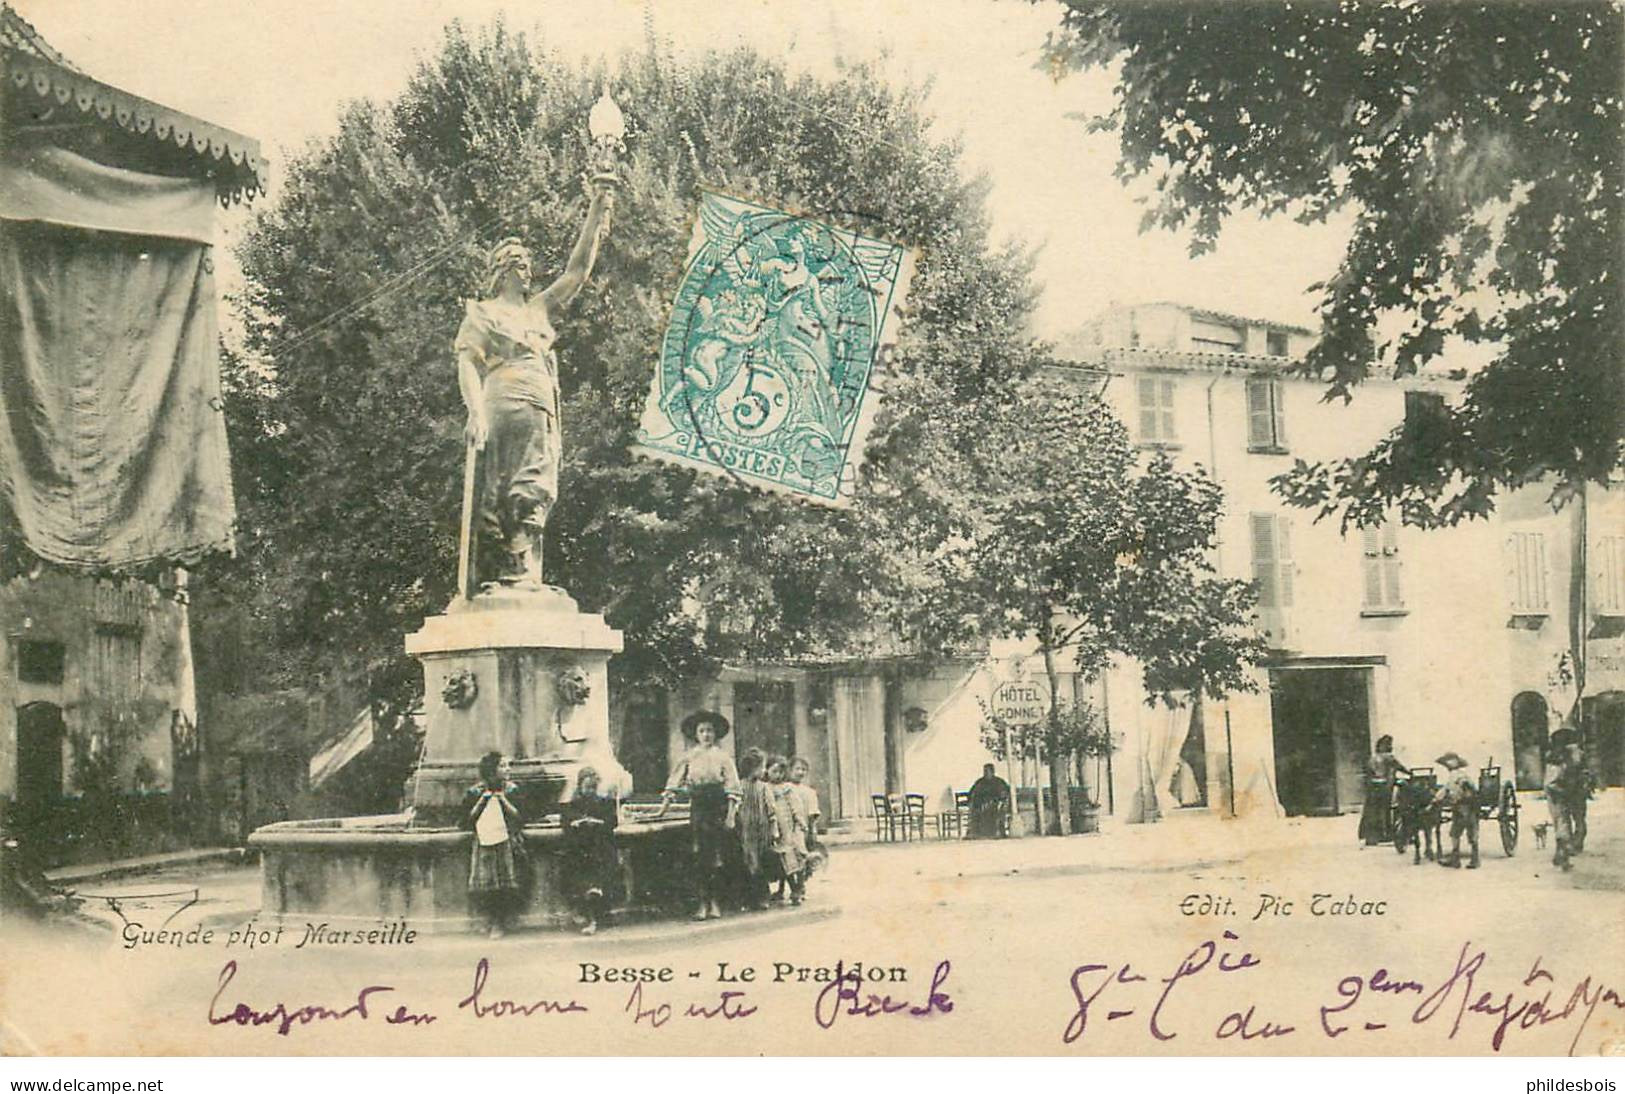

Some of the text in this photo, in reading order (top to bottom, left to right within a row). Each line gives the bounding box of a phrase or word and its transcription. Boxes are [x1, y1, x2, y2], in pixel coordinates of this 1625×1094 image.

[690, 438, 782, 476] POSTES
[999, 684, 1040, 702] HÔTEL
[1215, 1005, 1296, 1040] du
